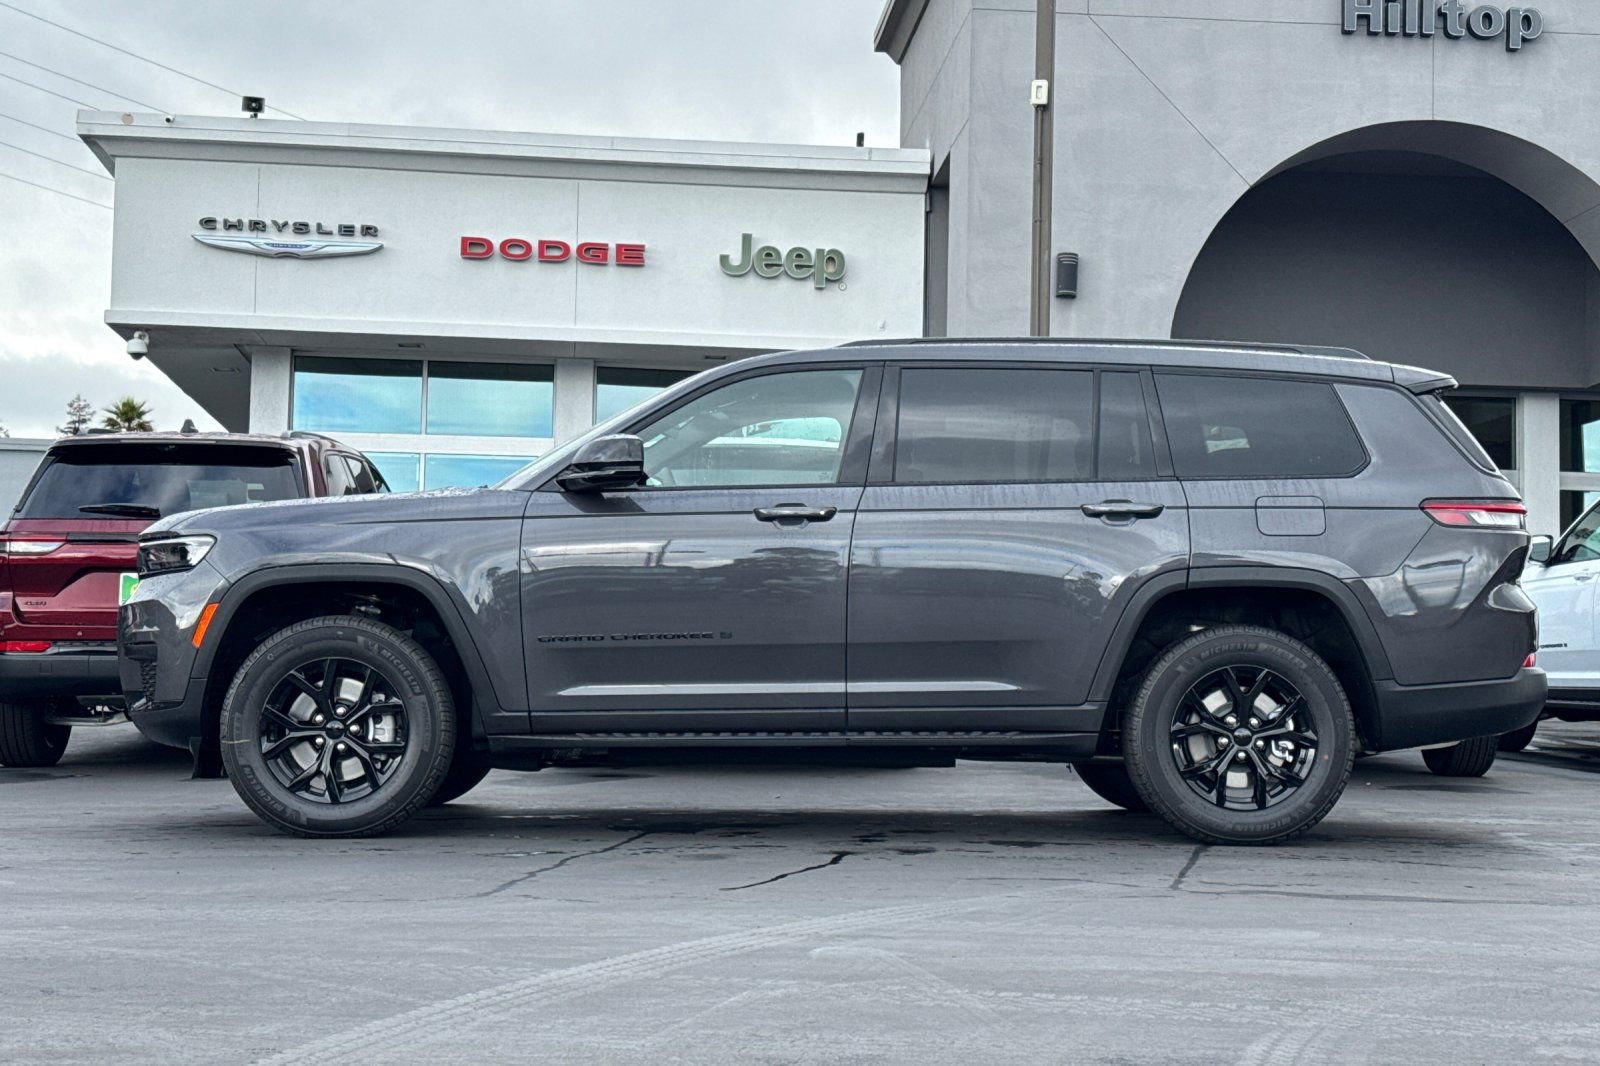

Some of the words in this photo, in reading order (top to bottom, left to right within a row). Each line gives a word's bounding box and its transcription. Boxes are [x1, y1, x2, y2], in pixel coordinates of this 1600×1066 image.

[1342, 0, 1544, 50] Hilltop
[199, 216, 379, 237] CHRYSLER
[461, 236, 645, 266] DODGE
[719, 233, 846, 290] Jeep
[537, 634, 605, 643] GRAND
[610, 632, 714, 642] CHEROKEE
[1200, 642, 1258, 660] MICHELIN
[380, 649, 422, 695] MICHELIN
[242, 766, 285, 812] MICHELIN
